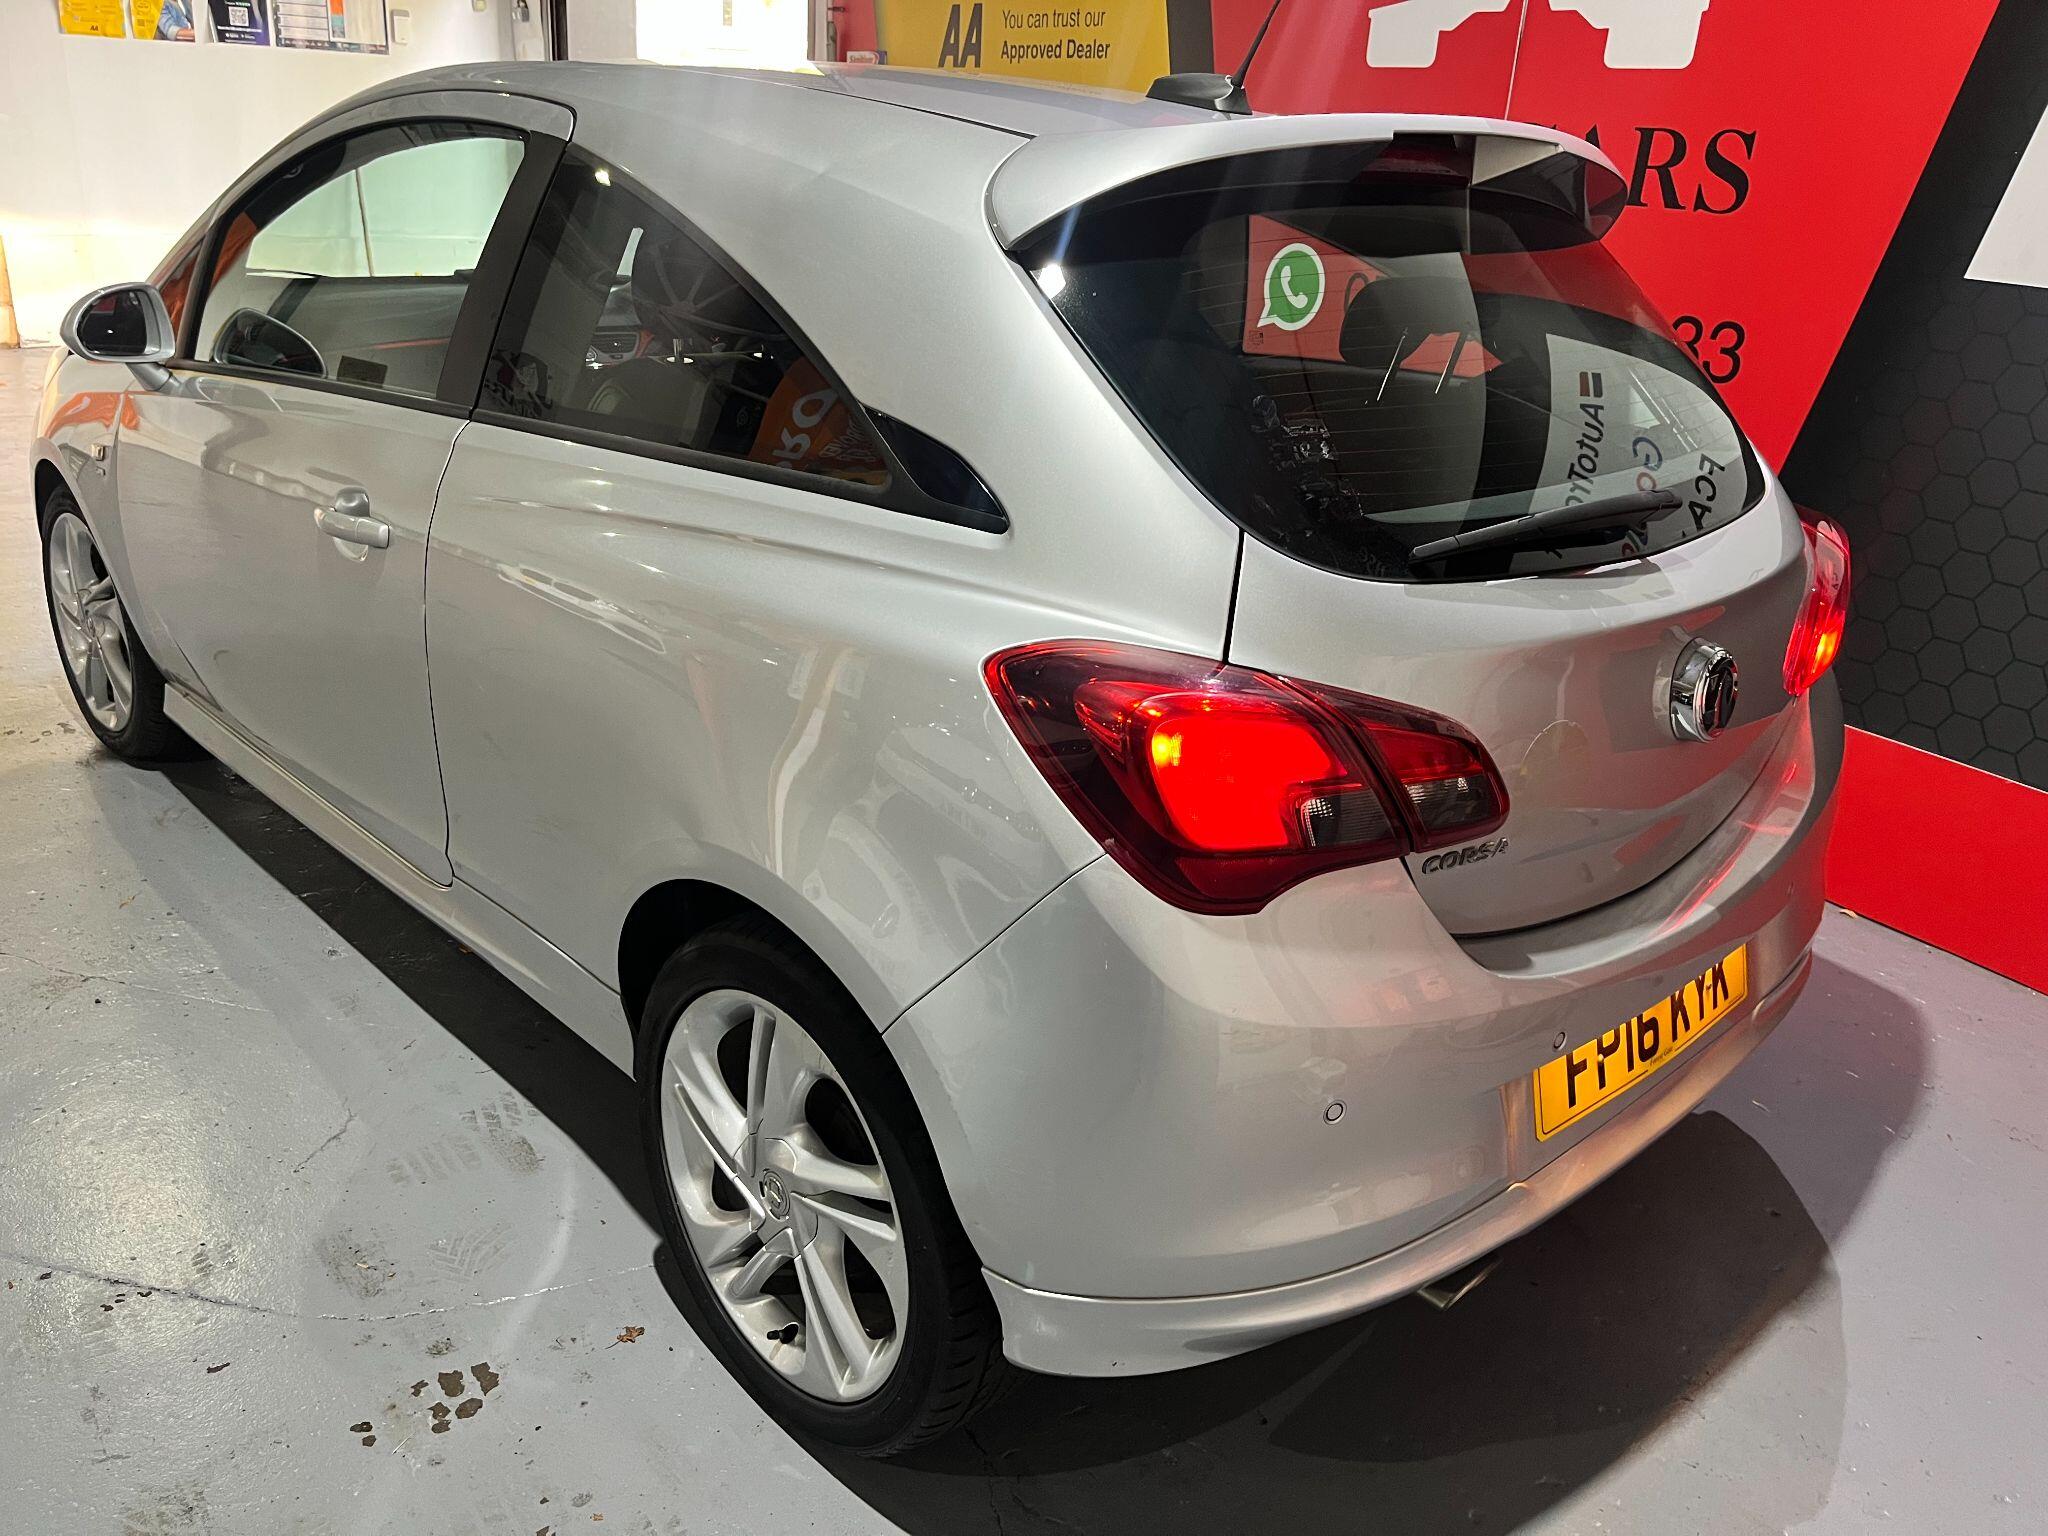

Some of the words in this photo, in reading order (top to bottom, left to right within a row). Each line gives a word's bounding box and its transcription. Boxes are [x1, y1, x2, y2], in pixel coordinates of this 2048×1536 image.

[938, 3, 983, 68] AA
[1002, 10, 1023, 29] You
[1027, 12, 1049, 28] can
[1052, 8, 1081, 27] trust
[1084, 11, 1106, 27] our
[1001, 40, 1063, 64] Approved
[1066, 39, 1110, 59] Dealer
[1421, 837, 1509, 875] CORSA
[1565, 1012, 1660, 1109] FP16
[1669, 959, 1729, 1043] KYK
